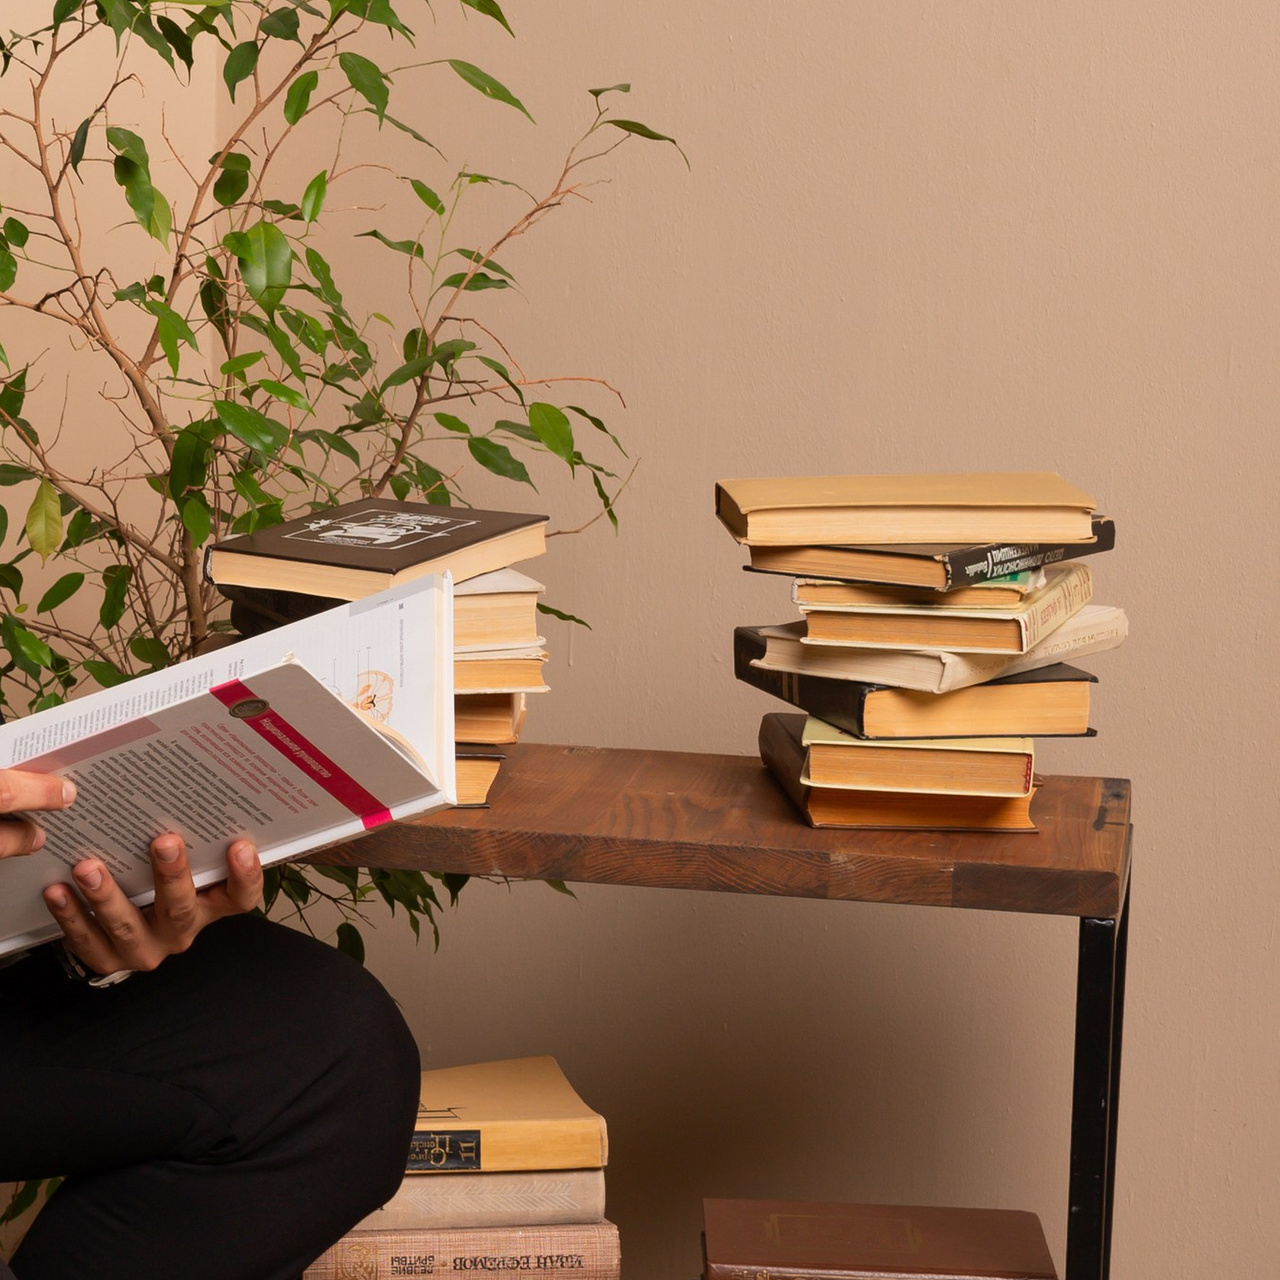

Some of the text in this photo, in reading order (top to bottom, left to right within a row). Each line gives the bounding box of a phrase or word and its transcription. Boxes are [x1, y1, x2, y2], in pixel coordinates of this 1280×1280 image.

[1044, 548, 1065, 562] ДЕЛО
[258, 718, 331, 778] Национальное руководство
[391, 1255, 435, 1266] БРИТВЫ
[453, 1254, 585, 1271] ИВАН ЕФРЕМОВ
[391, 1265, 435, 1275] ЛЕЗВИЕ
